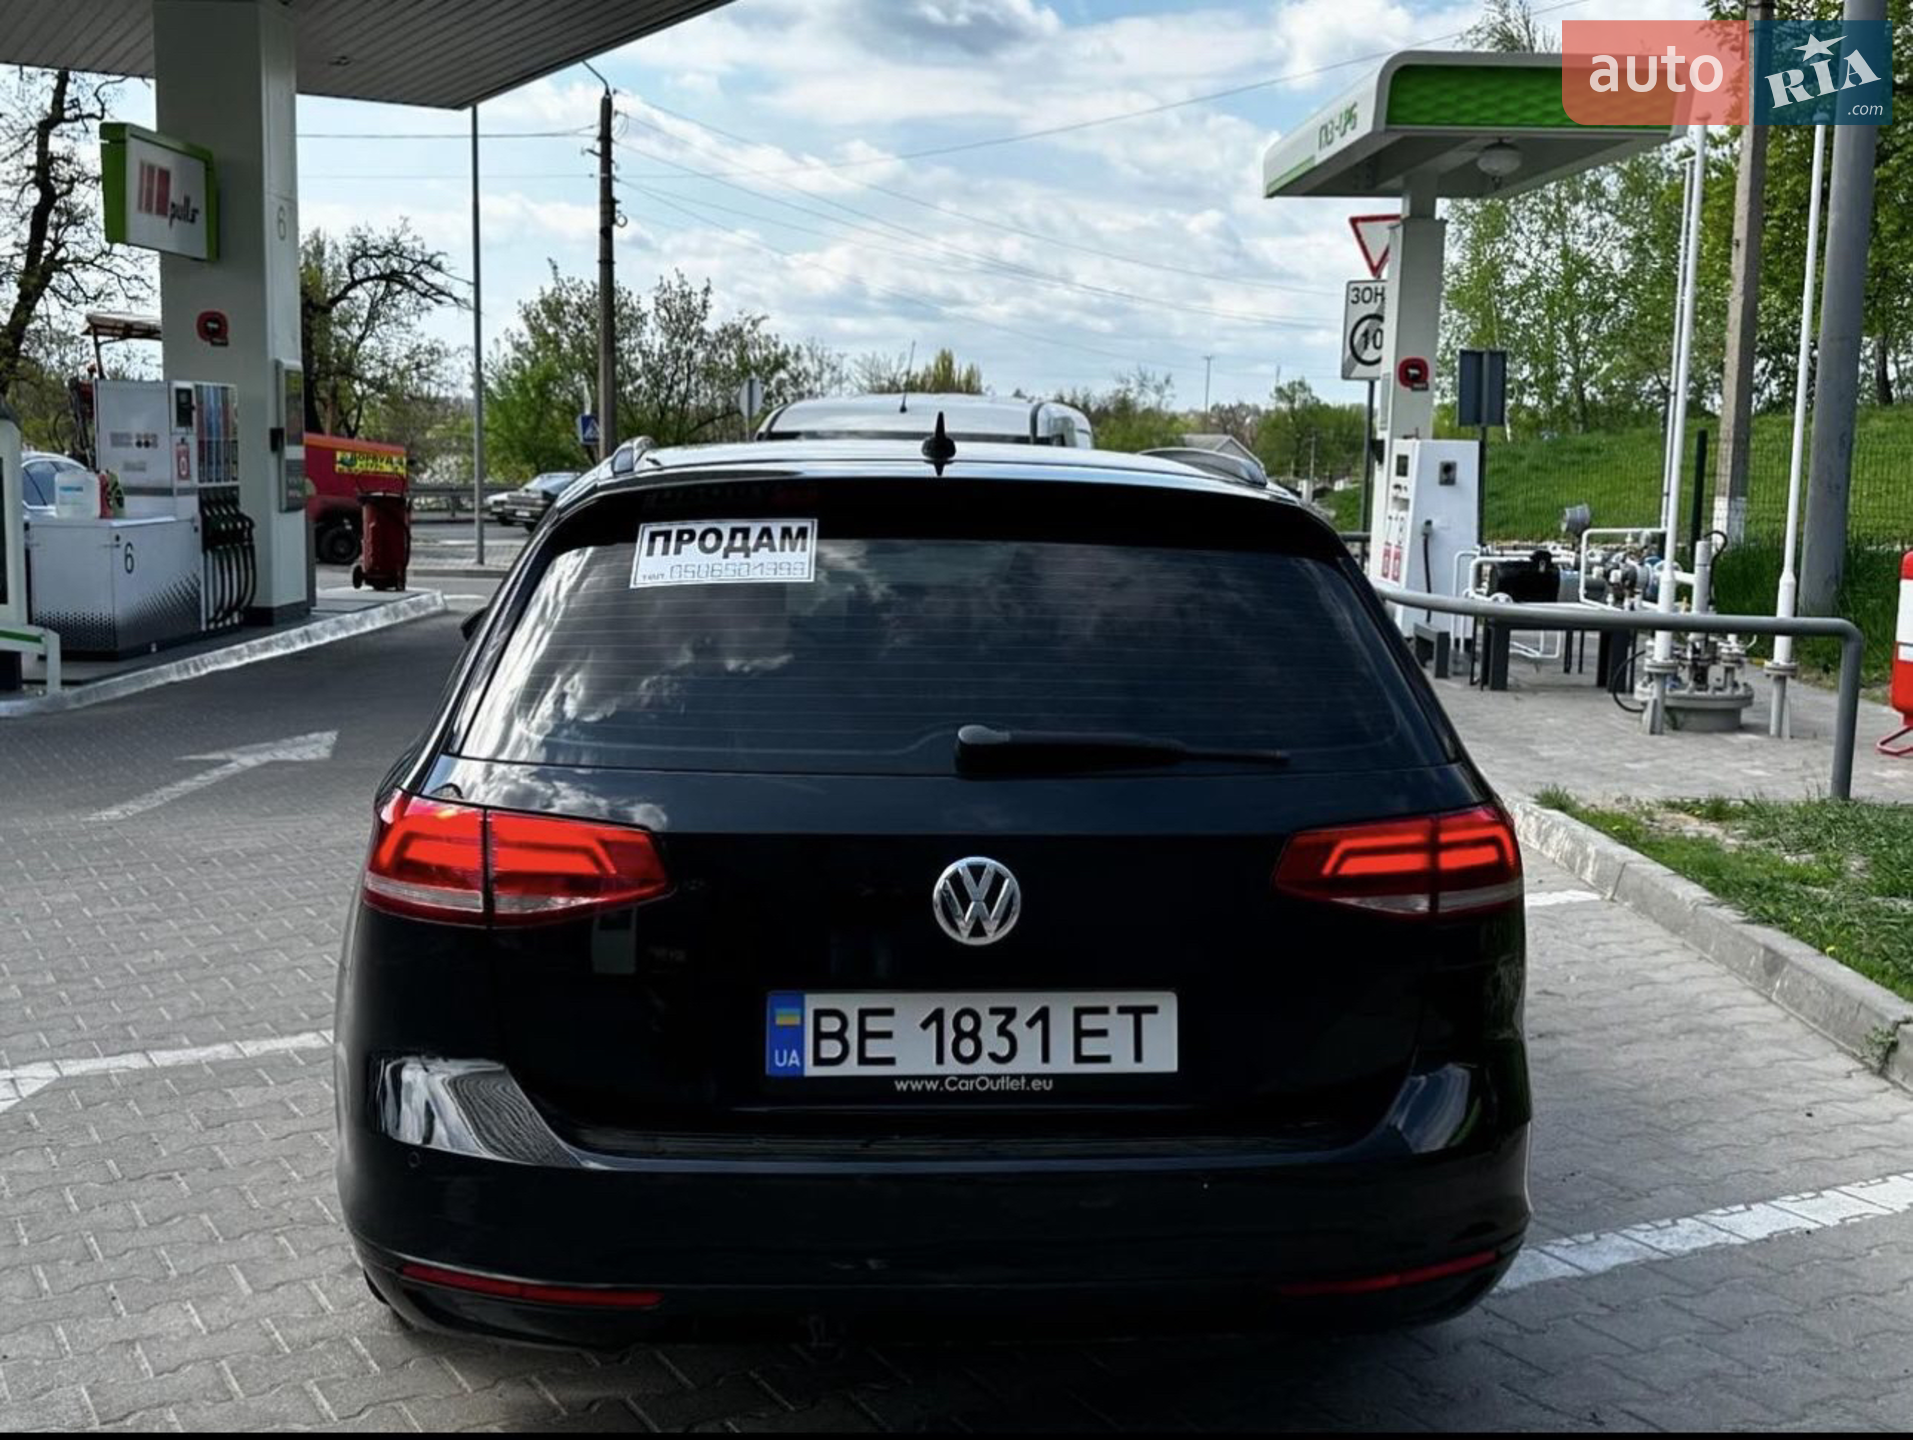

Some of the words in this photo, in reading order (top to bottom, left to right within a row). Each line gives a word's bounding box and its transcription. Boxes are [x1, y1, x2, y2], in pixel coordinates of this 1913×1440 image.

[276, 205, 287, 241] 6
[1350, 285, 1386, 304] ЗОН
[123, 541, 135, 575] 6
[646, 525, 809, 559] ПРОДАМ
[774, 1049, 801, 1067] UA
[811, 1007, 897, 1067] BE
[918, 1005, 1051, 1066] 1831
[1072, 1004, 1159, 1065] ET
[894, 1075, 1054, 1092] www.CarOutlet.eu
